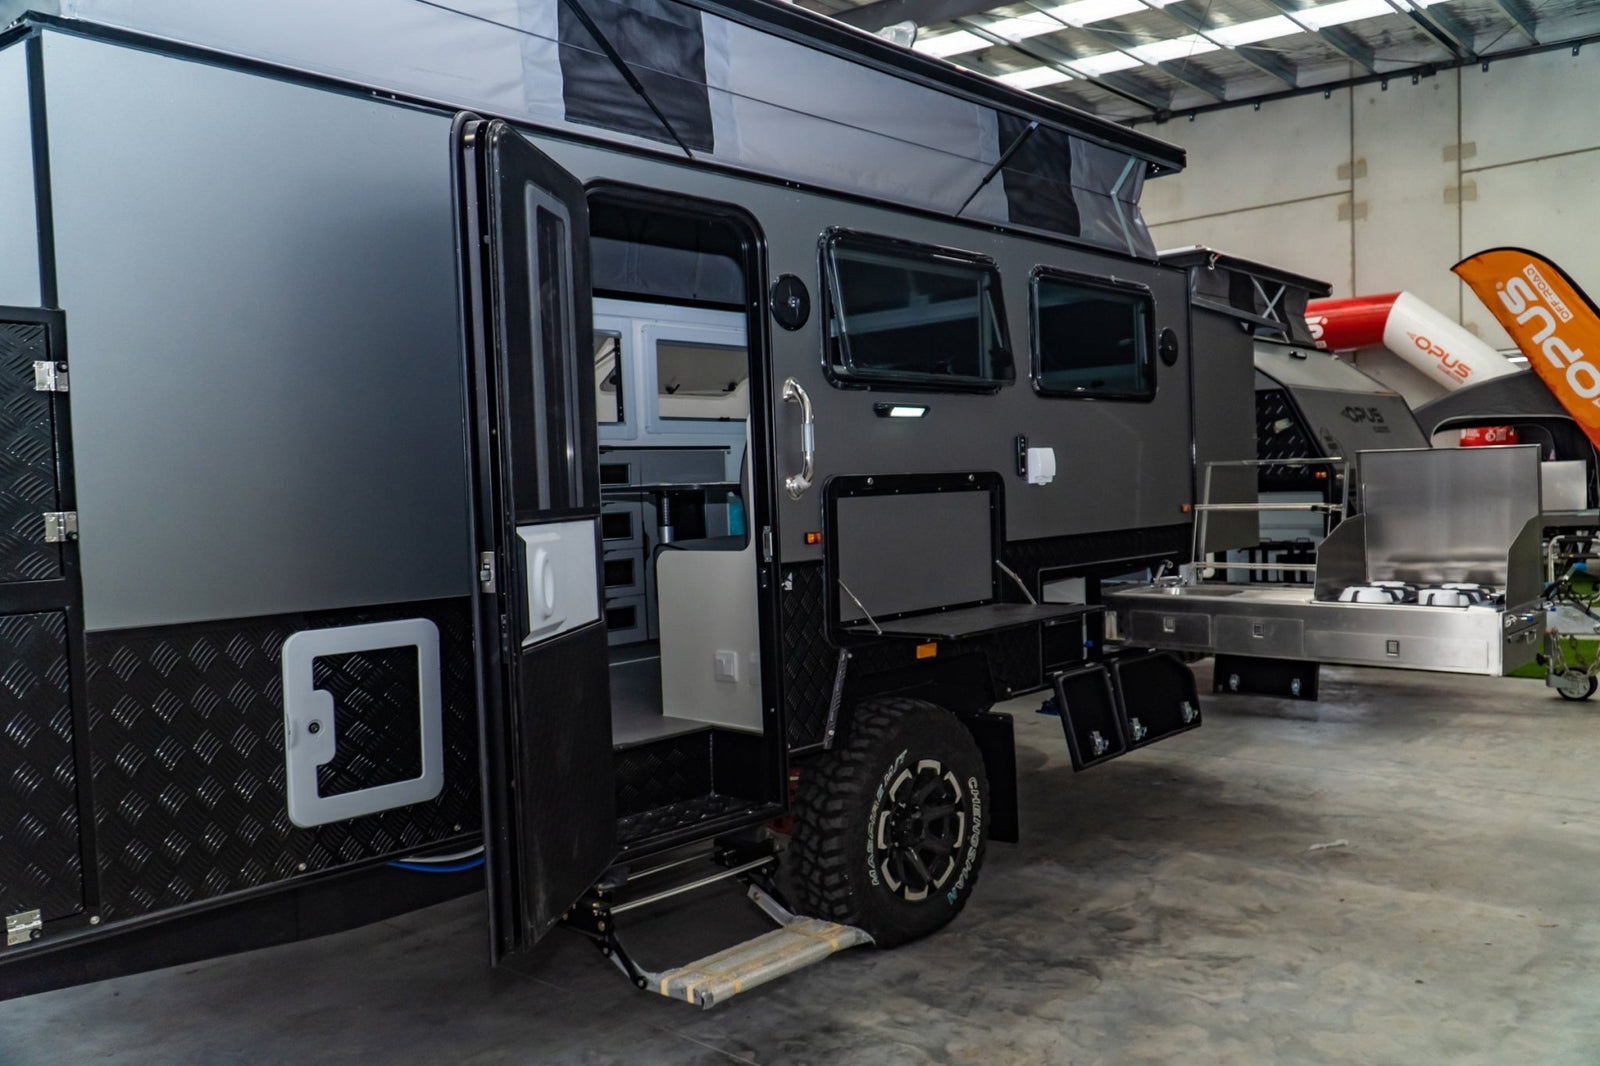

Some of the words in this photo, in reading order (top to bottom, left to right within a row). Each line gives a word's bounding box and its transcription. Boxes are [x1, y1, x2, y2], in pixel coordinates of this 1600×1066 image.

[1527, 267, 1570, 321] OFF-ROAD
[1415, 336, 1472, 379] OPUS
[1496, 277, 1600, 399] OPUS
[1344, 406, 1384, 423] OPUS
[947, 776, 982, 905] CHENGSHAN
